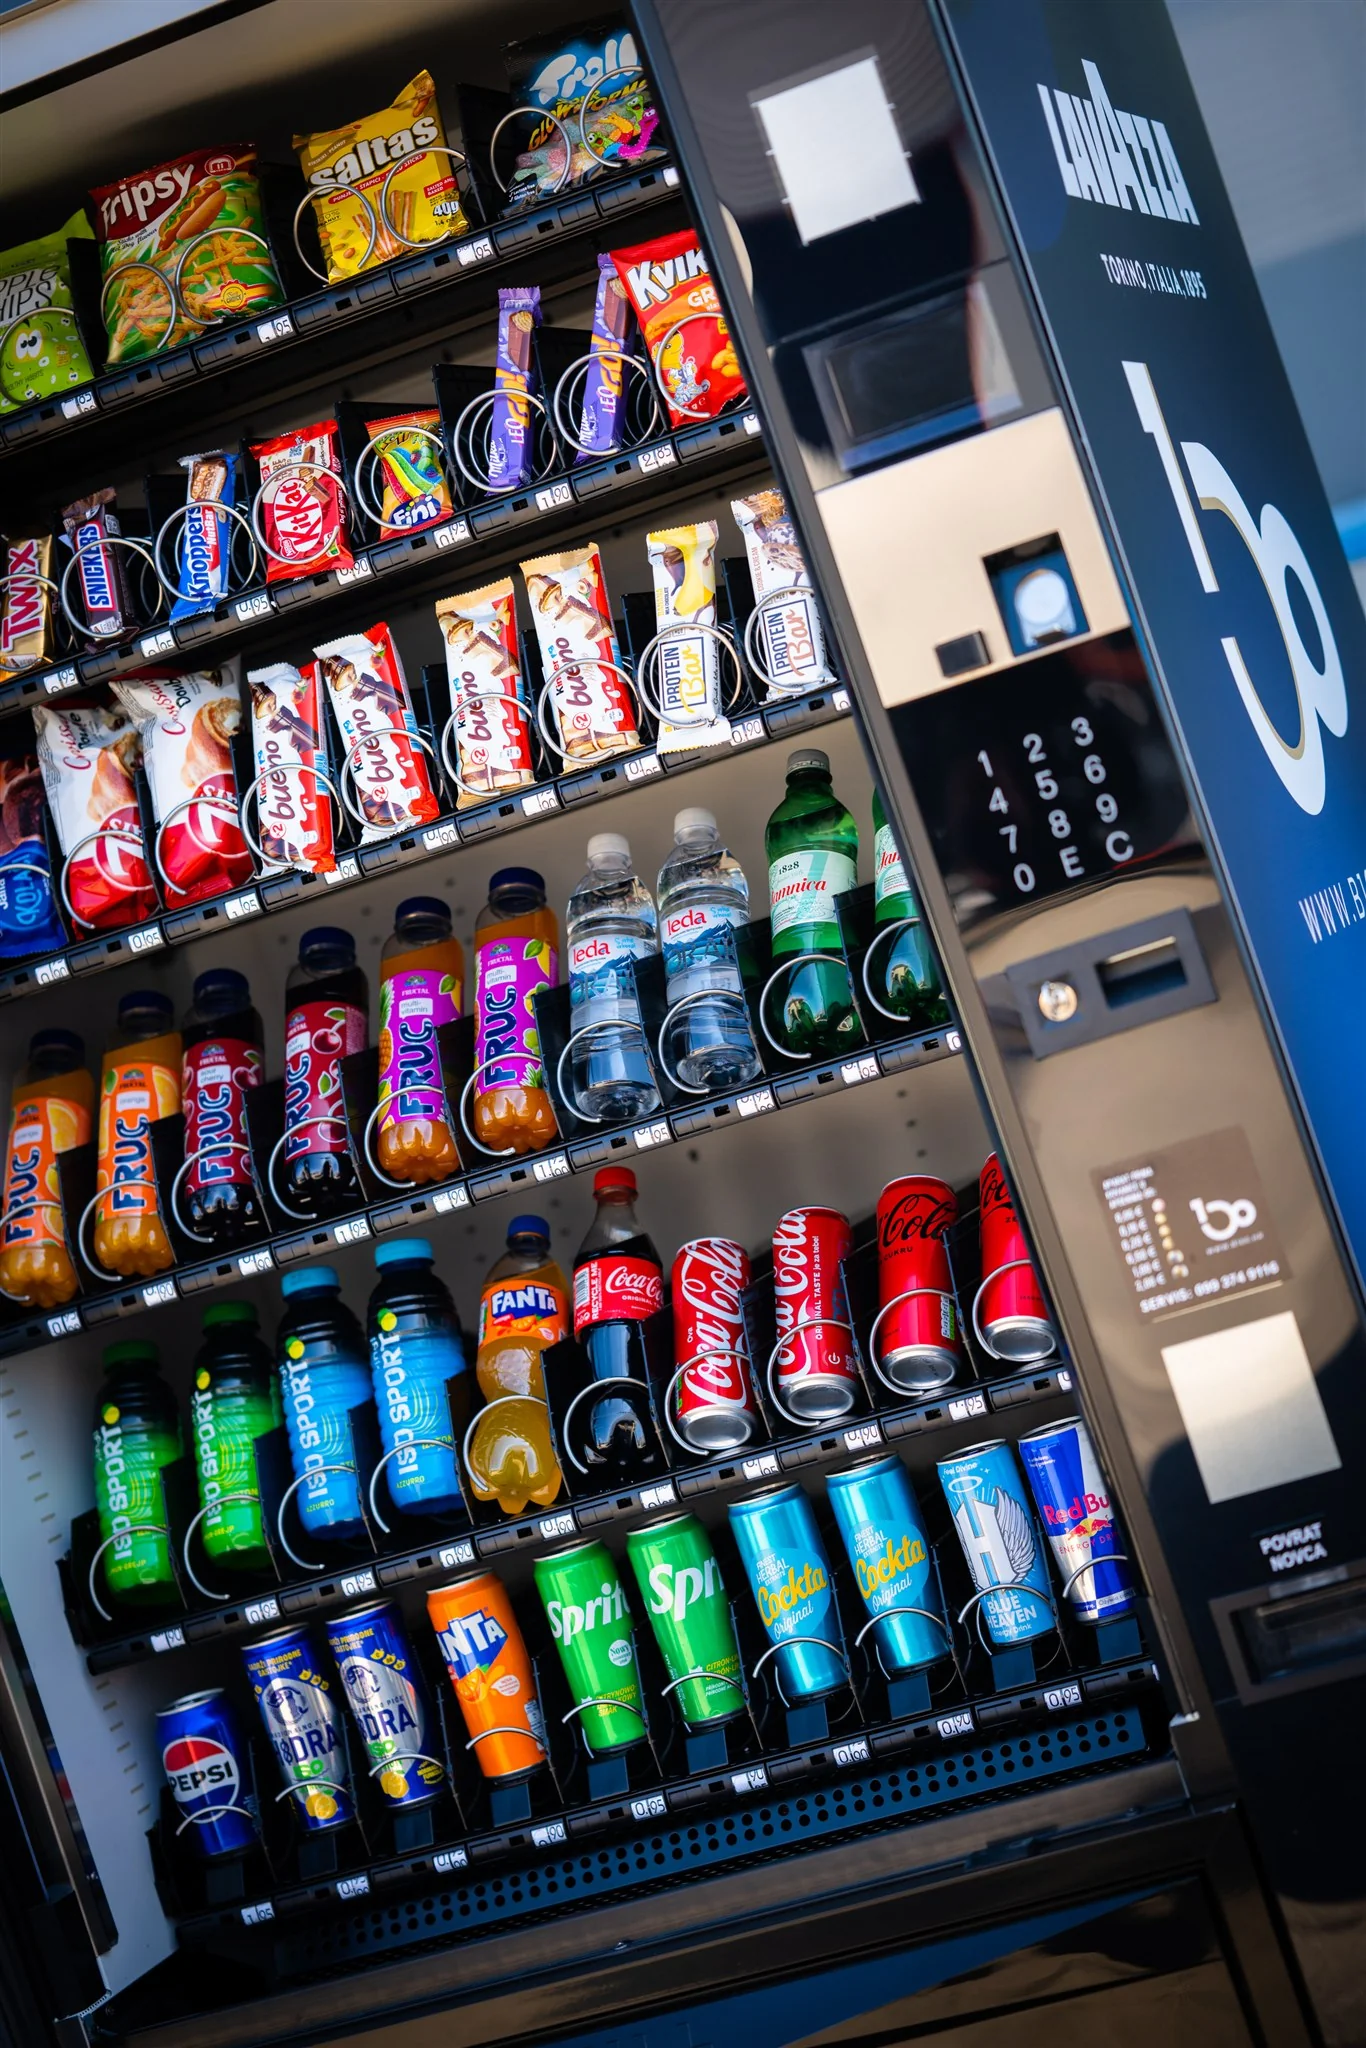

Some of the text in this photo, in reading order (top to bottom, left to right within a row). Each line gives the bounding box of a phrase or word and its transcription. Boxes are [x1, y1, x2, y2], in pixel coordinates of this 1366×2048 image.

[310, 116, 439, 197] saltas
[1036, 58, 1201, 226] LAVAZZA
[505, 417, 525, 446] LEO
[597, 386, 617, 415] LEO
[206, 508, 217, 546] NutBar
[275, 482, 318, 546] KitKat
[393, 495, 437, 526] Fini
[79, 524, 109, 605] SNICKERS
[186, 506, 212, 600] Knoppers
[556, 637, 592, 707] bueno
[767, 612, 787, 670] PROTEIN
[786, 609, 814, 676] Bar
[464, 670, 493, 741] bueno
[663, 647, 681, 705] PROTEIN
[677, 645, 706, 713] Bar
[359, 708, 394, 784] bueno
[977, 716, 1094, 778] 1 2 3
[268, 740, 295, 820] bueno
[989, 754, 1106, 814] 4 5 6
[999, 793, 1118, 853] 7 8 9
[778, 861, 800, 876] 1828
[1013, 830, 1134, 892] 0 E C
[484, 985, 518, 1088] FRUC
[400, 1018, 435, 1118] FRUC
[198, 1084, 234, 1183] FRUC
[286, 1053, 311, 1159] FRUC
[112, 1116, 148, 1211] FRUC
[6, 1148, 39, 1246] FRUC
[491, 1286, 557, 1319] FANTA
[591, 1279, 600, 1321] RECYCLE
[815, 1299, 823, 1340] ORIINAL
[286, 1358, 323, 1450] SPORT
[378, 1332, 412, 1424] SPORT
[195, 1390, 220, 1479] SPORT
[101, 1425, 129, 1512] SPORT
[854, 1532, 888, 1557] HERBAL
[1043, 1504, 1083, 1526] Red
[1259, 1521, 1323, 1555] POVRAT
[757, 1560, 790, 1583] HERBAL
[856, 1536, 926, 1600] Cockta
[1269, 1542, 1328, 1572] NOVCA
[757, 1563, 827, 1627] Cockta
[774, 1601, 813, 1640] Original
[872, 1576, 912, 1613] Original
[986, 1605, 1037, 1629] HEAVEN
[987, 1594, 1021, 1614] BLUE
[1049, 1687, 1082, 1707] 0.95
[169, 1760, 234, 1793] PEPSI
[636, 1800, 668, 1816] 0.95
